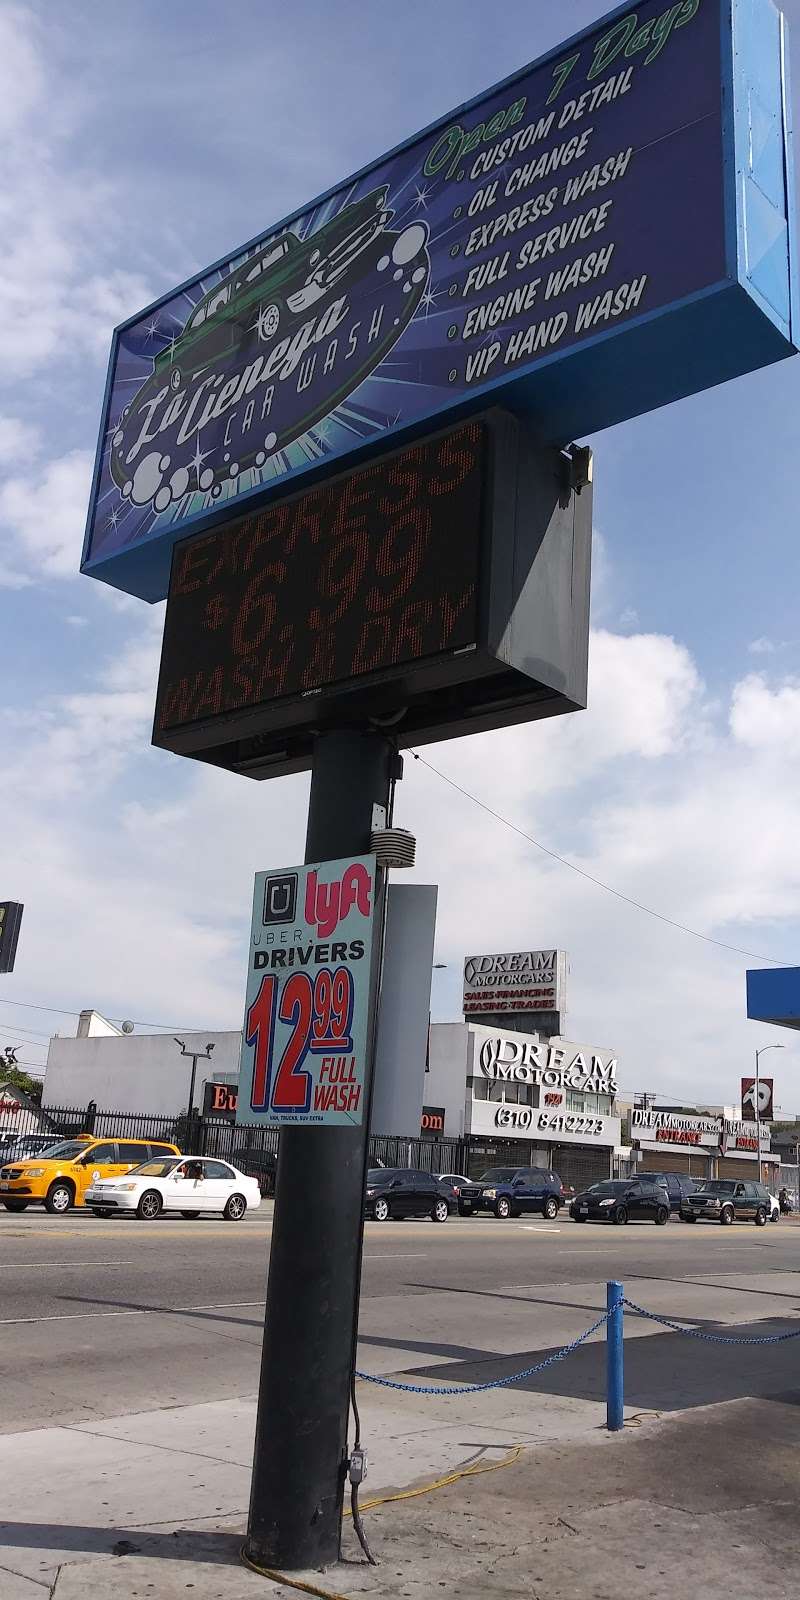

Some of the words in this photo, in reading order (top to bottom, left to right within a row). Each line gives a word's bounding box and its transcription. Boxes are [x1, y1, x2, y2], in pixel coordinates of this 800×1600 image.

[423, 97, 527, 181] Open
[546, 53, 580, 105] 7
[587, 0, 699, 80] Days
[470, 112, 556, 180] CUSTOM
[558, 66, 634, 129] DETAIL
[464, 187, 558, 256] EXPRESS
[562, 148, 633, 207] WASH
[468, 181, 499, 217] OIL
[504, 128, 594, 197] CHANGE
[462, 252, 510, 297] FULL
[515, 200, 613, 270] SERVICE
[462, 279, 541, 339] ENGINE
[544, 244, 615, 300] WASH
[465, 343, 501, 382] VIP
[504, 312, 568, 364] HAND
[574, 275, 647, 333] WASH
[126, 385, 187, 465] La
[176, 294, 350, 446] Cienega
[223, 385, 275, 446] CAR
[296, 304, 384, 393] WASH
[173, 424, 482, 594] EXPRESS
[158, 645, 295, 729] WASH
[351, 583, 477, 676] DRY
[253, 929, 302, 946] UBER
[304, 863, 372, 938] lyft
[254, 939, 365, 970] DRIVERS
[475, 971, 554, 987] MOTORCARS
[476, 951, 557, 973] DREAM
[313, 1085, 361, 1112] WASH
[319, 1057, 357, 1083] FULL
[496, 1039, 618, 1079] DREAM
[496, 1062, 620, 1094] MOTORCARS
[496, 1106, 534, 1129] (310)
